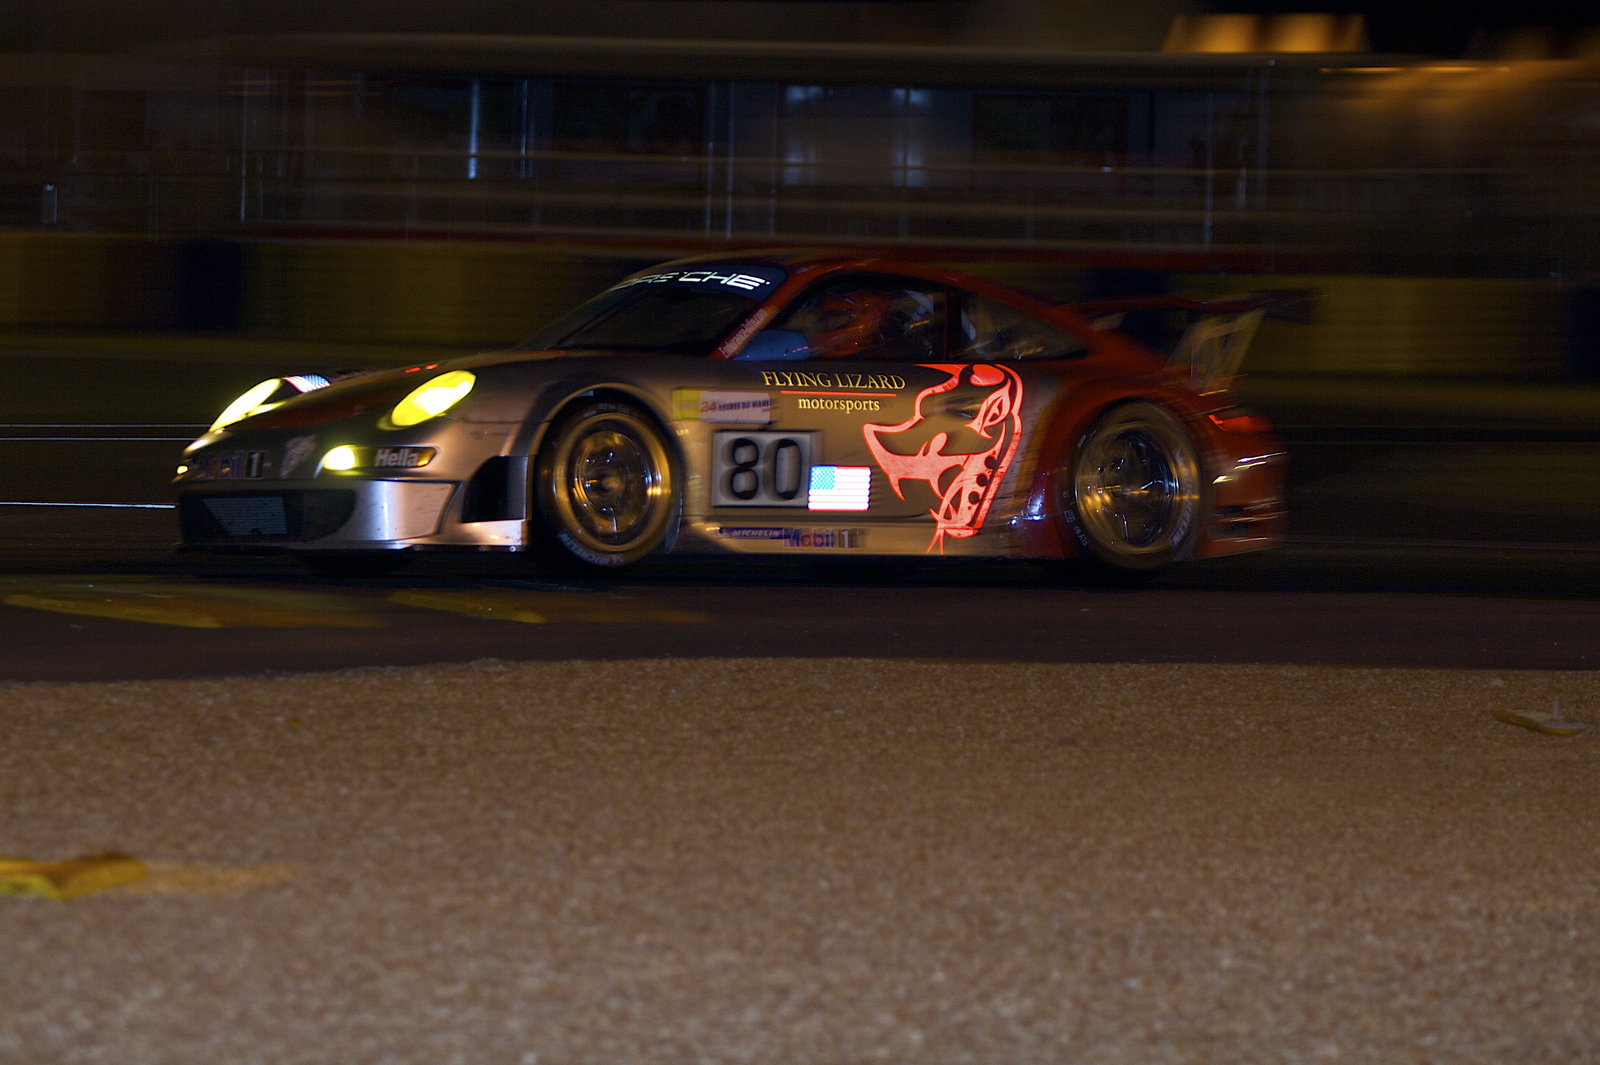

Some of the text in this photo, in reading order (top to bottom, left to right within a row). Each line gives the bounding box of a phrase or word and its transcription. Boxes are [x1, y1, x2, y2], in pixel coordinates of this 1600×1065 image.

[761, 370, 907, 391] FLYING LIZARD
[700, 401, 718, 413] 24
[798, 397, 880, 414] motorsports
[374, 448, 419, 467] Hella
[723, 437, 801, 501] 80
[731, 529, 781, 537] MICHELIN
[784, 528, 834, 547] Mobil
